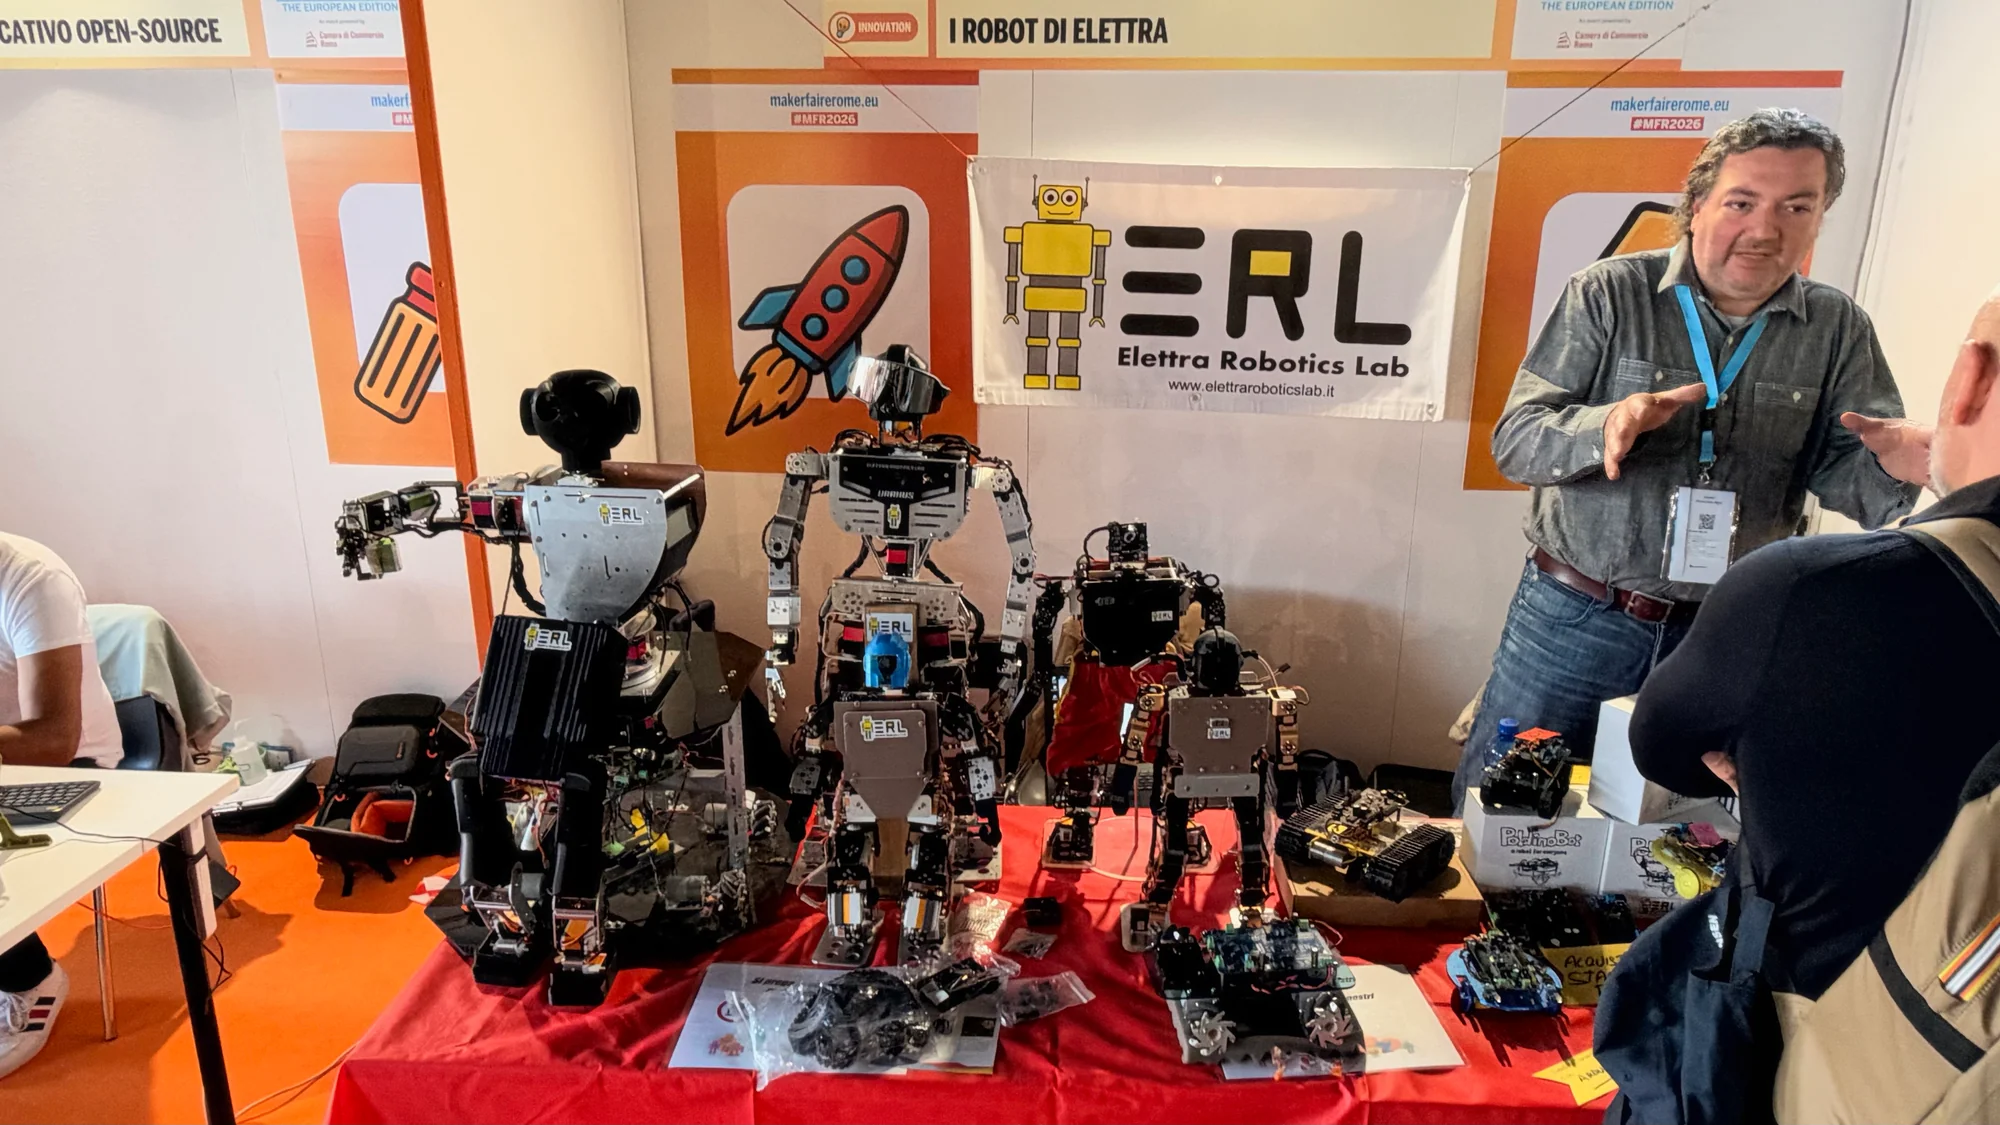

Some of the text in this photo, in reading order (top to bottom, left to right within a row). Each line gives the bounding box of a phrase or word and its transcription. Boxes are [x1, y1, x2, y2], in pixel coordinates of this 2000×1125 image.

[282, 2, 399, 12] THE EUROPEAN EDITION
[1541, 0, 1674, 11] THE EUROPEAN EDITION
[75, 18, 223, 43] OPEN-SOURCE
[858, 21, 912, 33] INNOVATION
[949, 17, 1169, 44] I ROBOT DI ELETTRA
[1575, 31, 1601, 40] Camera
[1610, 31, 1649, 39] Commercio
[770, 92, 879, 108] makerfairerome.eu
[1610, 96, 1730, 112] makerfairerome.eu
[793, 114, 857, 125] #MFR2026
[1632, 118, 1702, 130] #MFR2026
[1120, 225, 1412, 346] ERL
[1118, 345, 1410, 379] Elettra Robotics Lab
[1168, 379, 1335, 398] www.elettraroboticslab.it
[611, 507, 642, 521] ERL
[880, 620, 912, 633] ERL
[538, 630, 571, 646] ERL
[874, 720, 907, 733] ERL
